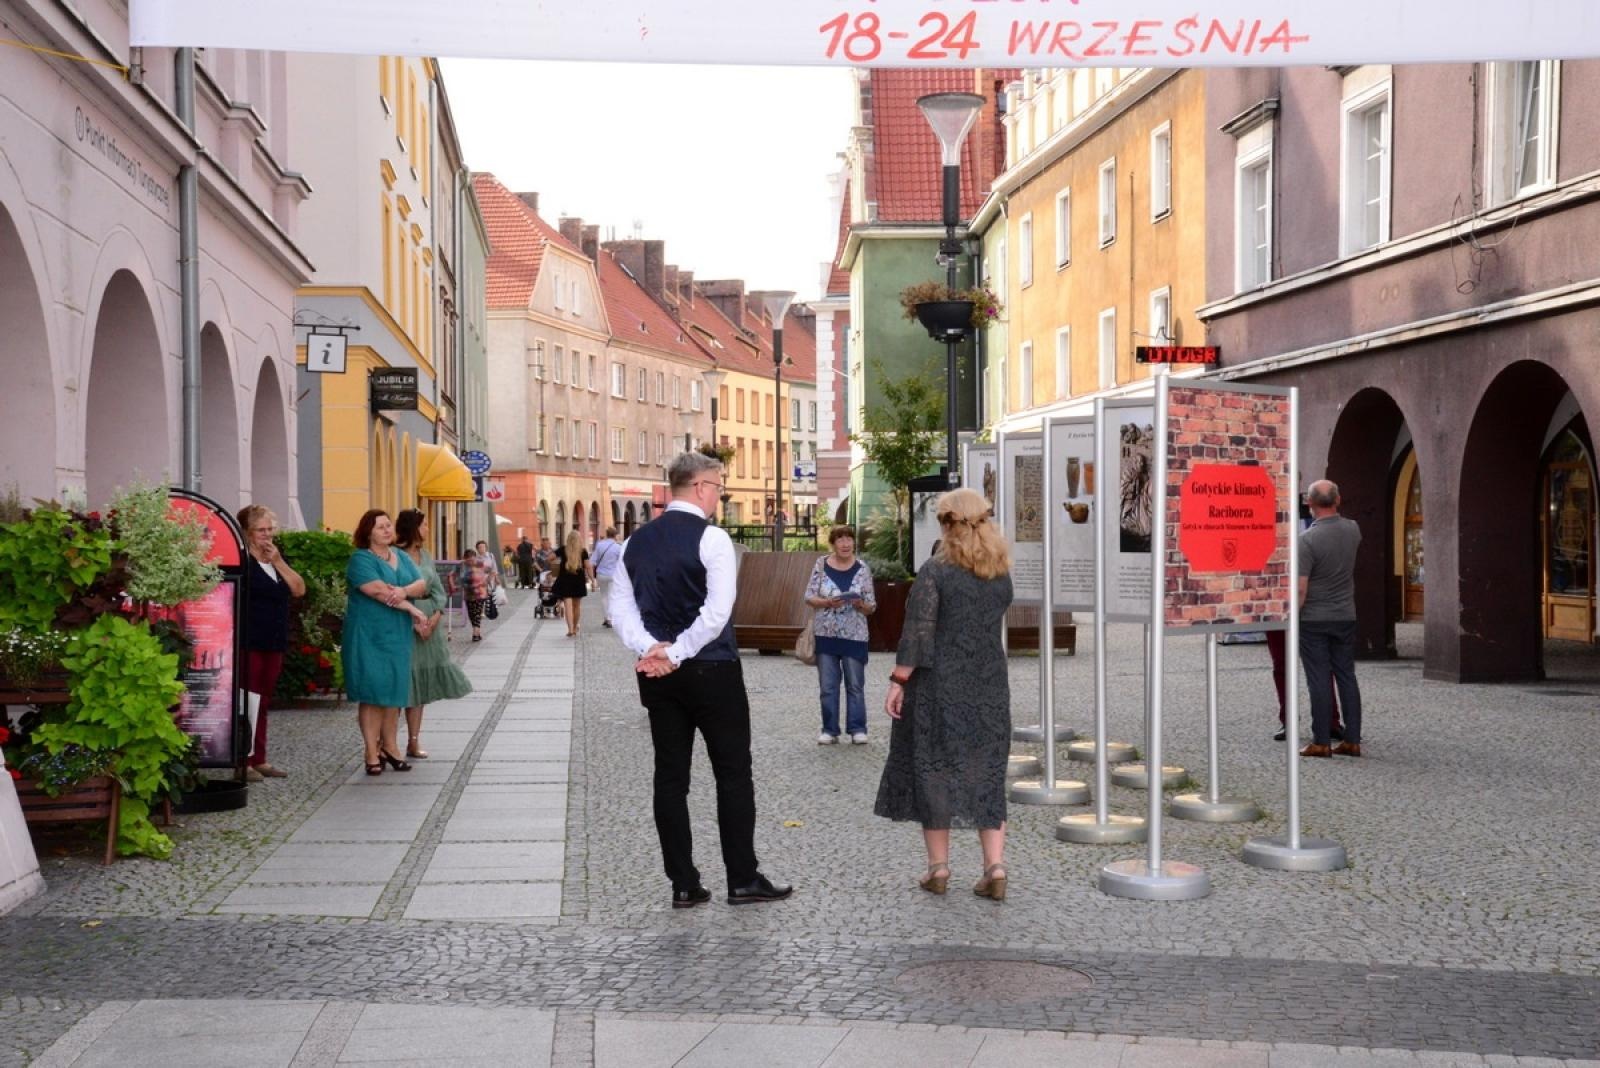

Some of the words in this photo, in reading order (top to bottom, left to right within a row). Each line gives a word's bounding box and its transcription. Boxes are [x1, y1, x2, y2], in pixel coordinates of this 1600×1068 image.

[819, 10, 980, 61] 18-24
[1006, 13, 1310, 62] WRZEŚNIA
[85, 116, 105, 156] Punkt
[106, 134, 137, 186] Informacji
[376, 375, 415, 384] JUBILER
[1191, 481, 1232, 498] Gotyckie
[1234, 482, 1266, 498] klimaty
[1208, 505, 1254, 518] Raciborza
